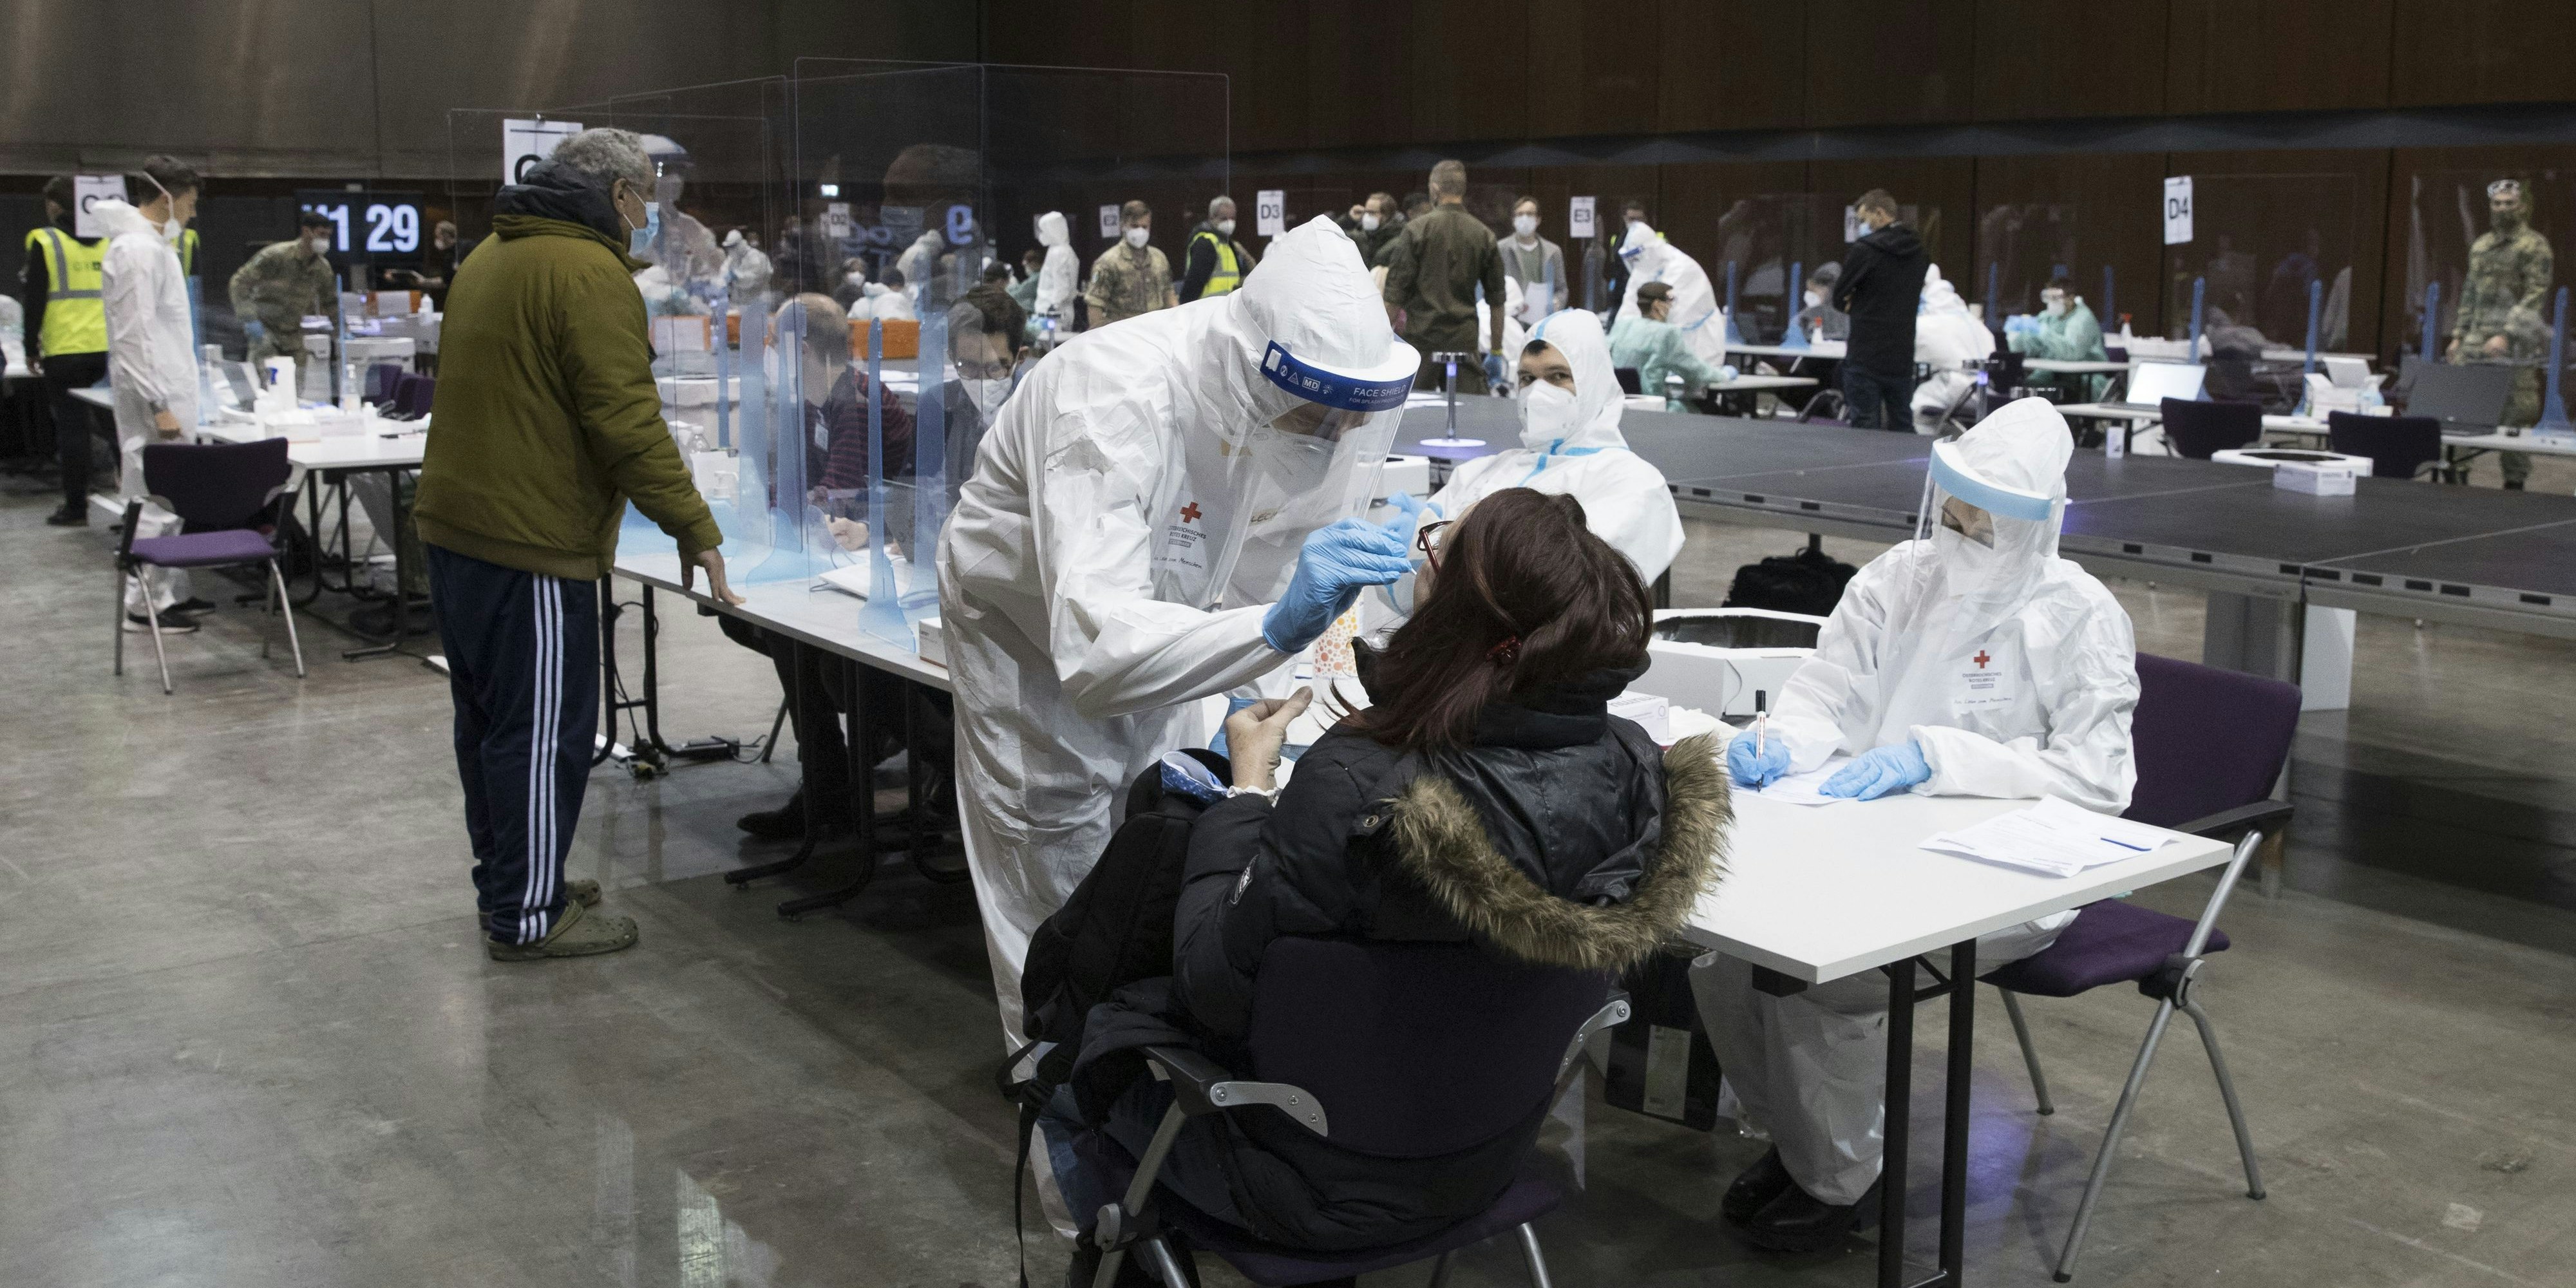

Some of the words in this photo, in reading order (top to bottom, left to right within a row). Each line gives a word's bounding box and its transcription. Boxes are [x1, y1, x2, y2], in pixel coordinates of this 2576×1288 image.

[1260, 204, 1280, 219] D3
[2168, 196, 2188, 219] D4
[1574, 209, 1591, 223] E3
[365, 204, 419, 252] 29
[1303, 379, 1319, 390] MD
[1353, 388, 1379, 397] FACE
[1380, 384, 1406, 397] SHIELD
[1180, 533, 1197, 542] KREUZ
[1179, 556, 1202, 569] Menschen
